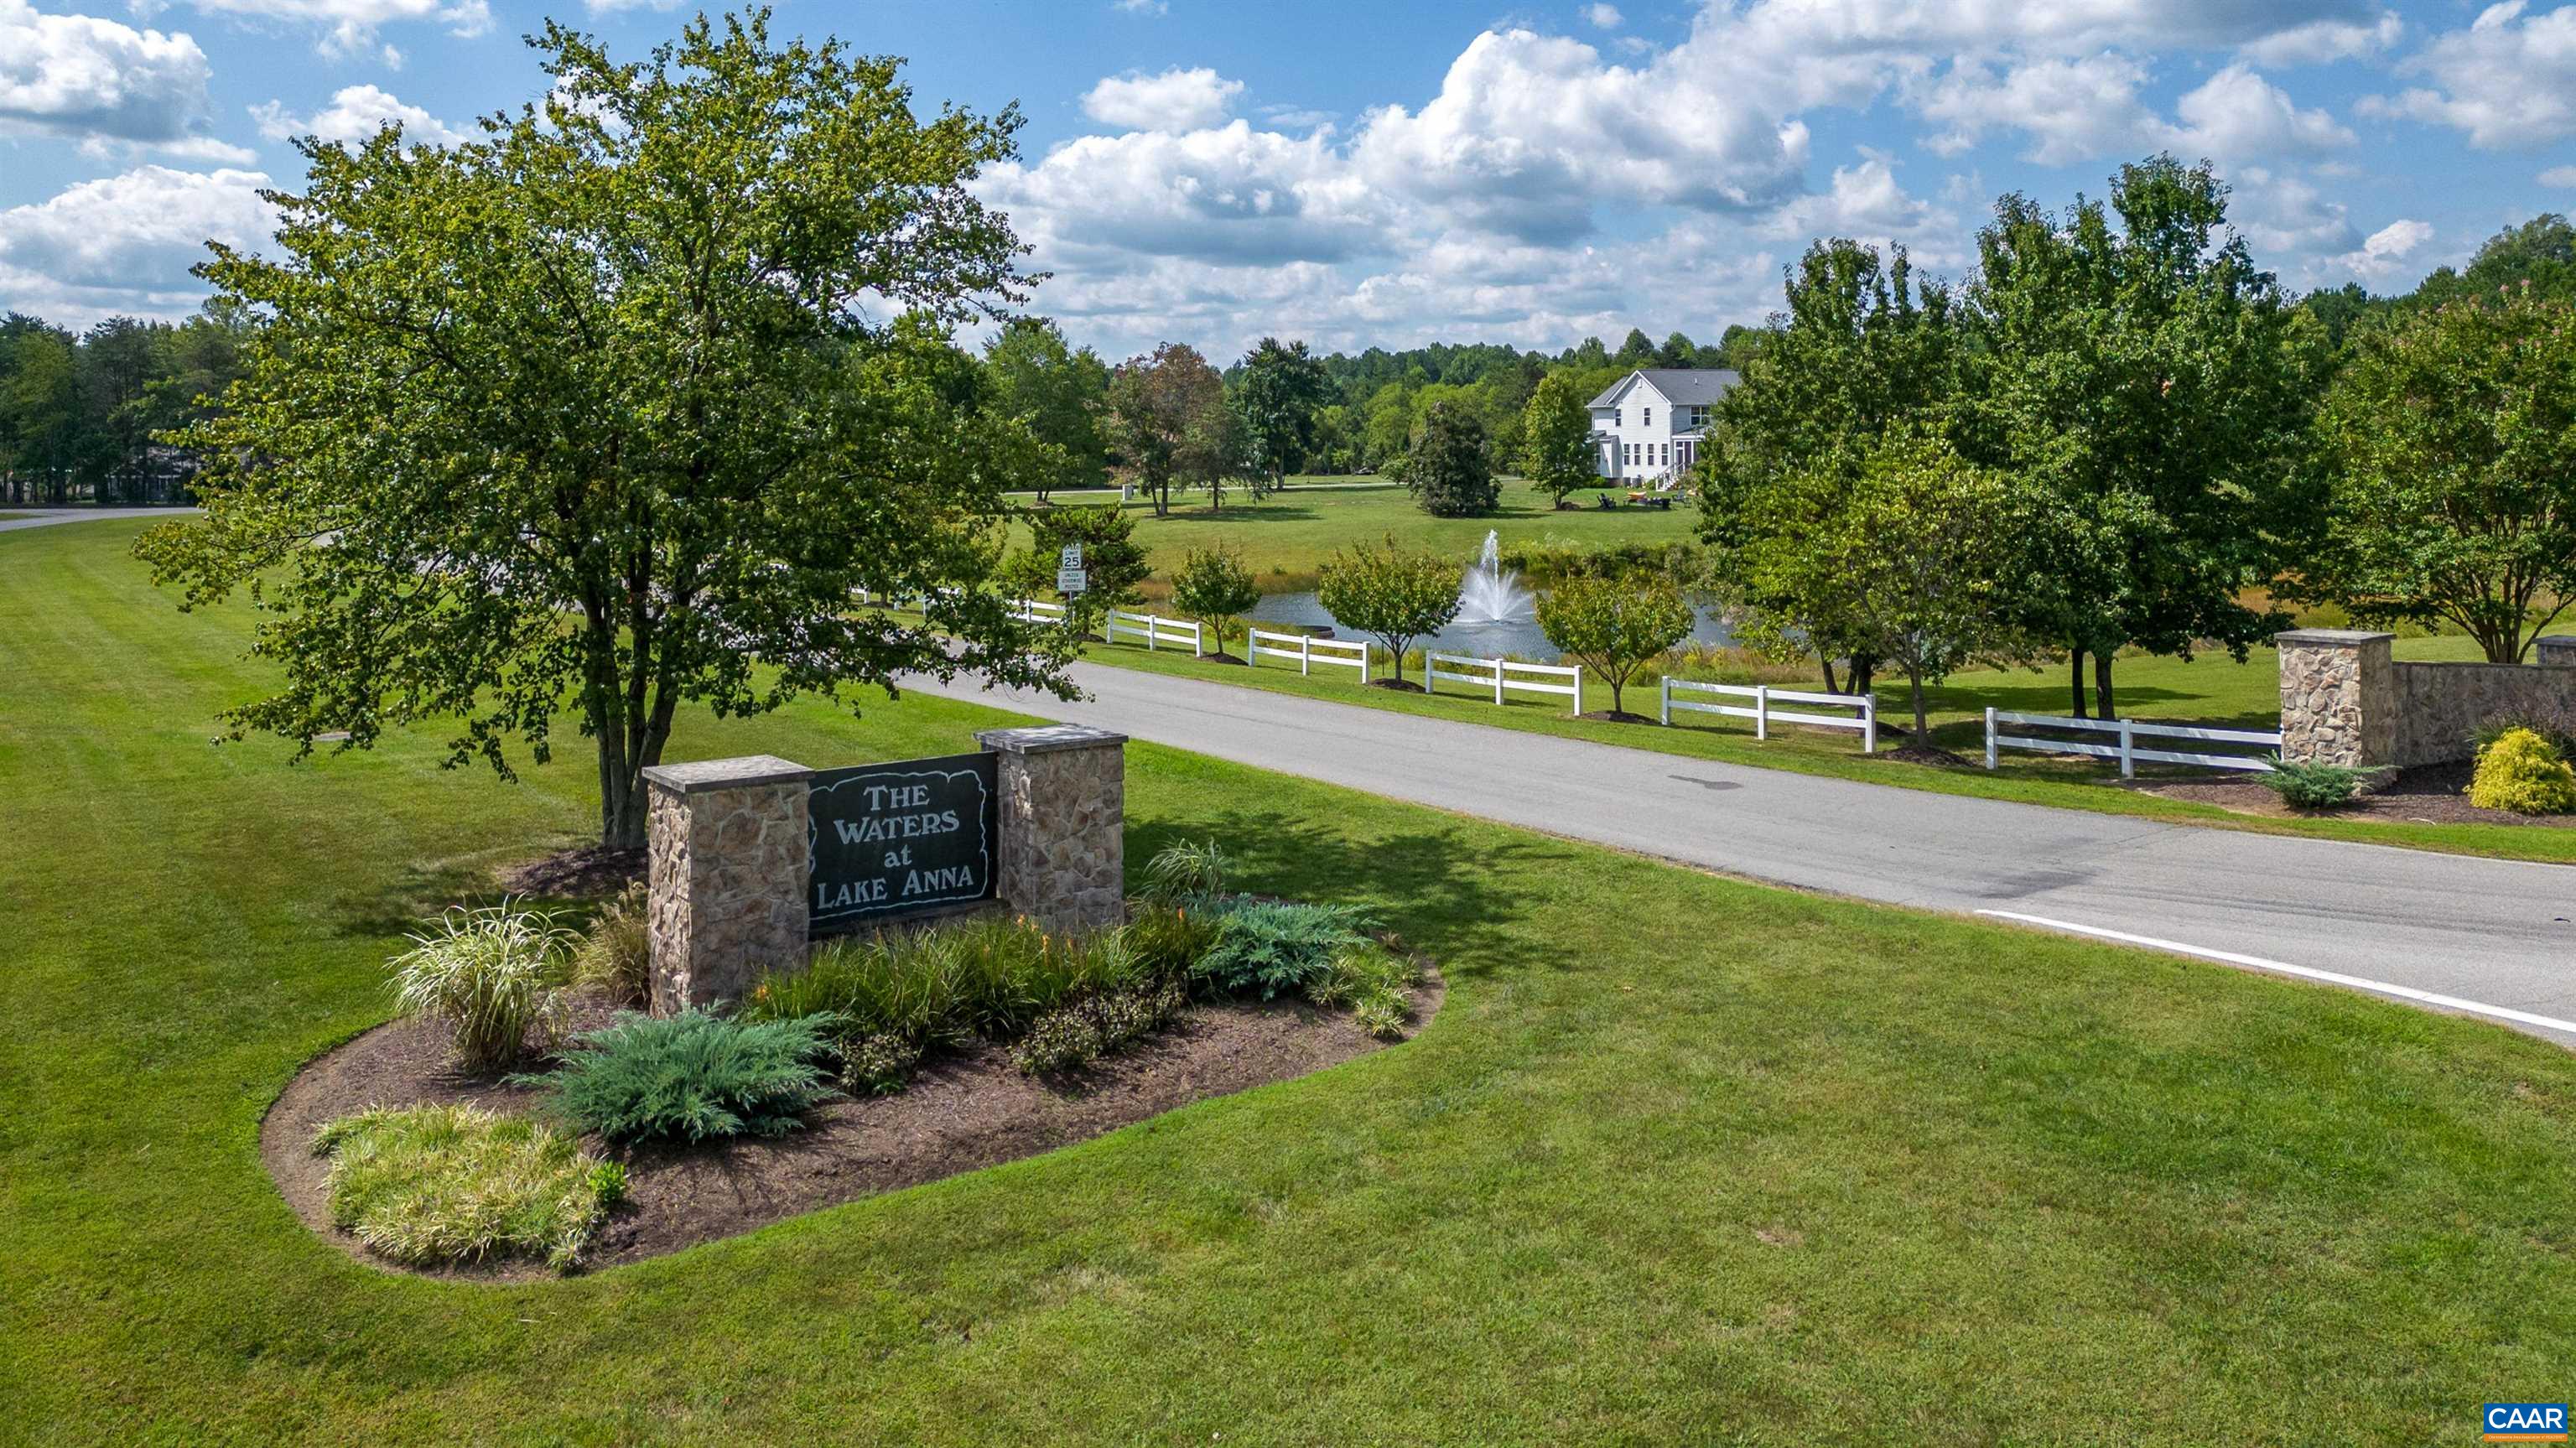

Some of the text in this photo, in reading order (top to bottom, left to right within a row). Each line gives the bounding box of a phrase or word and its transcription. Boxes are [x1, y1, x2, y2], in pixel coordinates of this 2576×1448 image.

[1064, 557, 1079, 567] 25
[863, 785, 930, 812] THE
[833, 809, 960, 844] WATERS
[884, 844, 912, 868] at
[818, 864, 974, 910] LAKE ANNA
